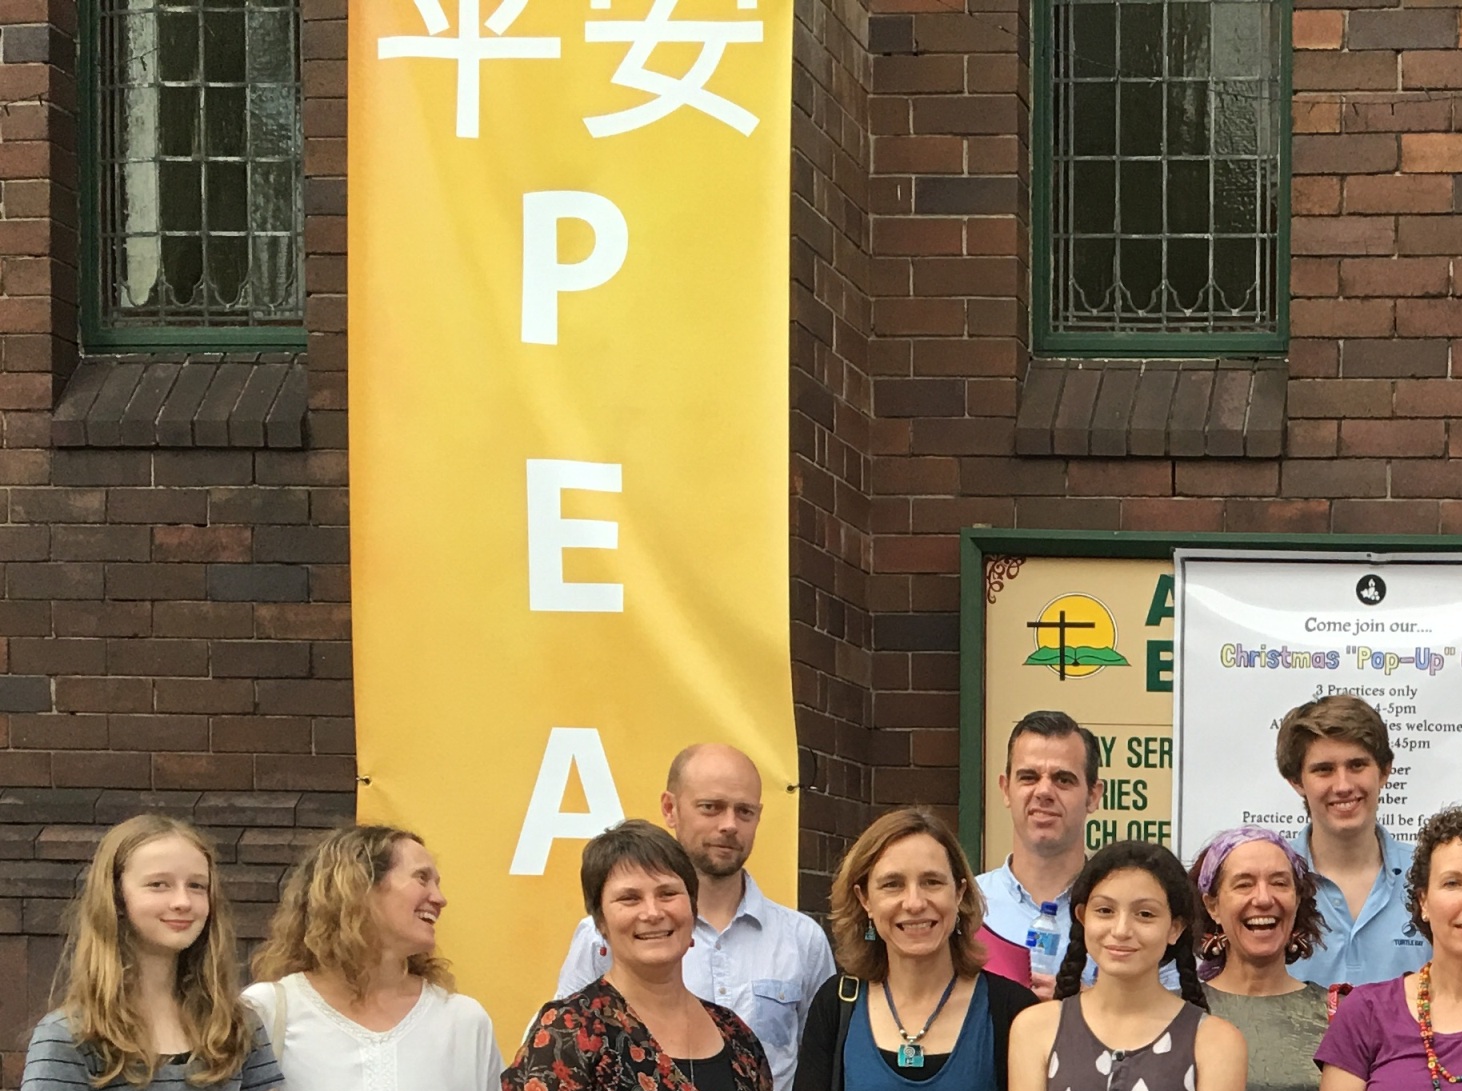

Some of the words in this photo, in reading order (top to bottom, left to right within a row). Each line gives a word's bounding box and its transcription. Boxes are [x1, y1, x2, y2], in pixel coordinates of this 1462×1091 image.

[1304, 617, 1351, 633] Come
[1352, 618, 1385, 636] join
[1389, 621, 1433, 634] our....
[1220, 643, 1340, 670] Christmas
[1315, 684, 1323, 696] 3
[1328, 685, 1385, 697] Practices
[1389, 685, 1418, 699] only
[1242, 811, 1293, 824] Practice
[1398, 813, 1414, 826] be
